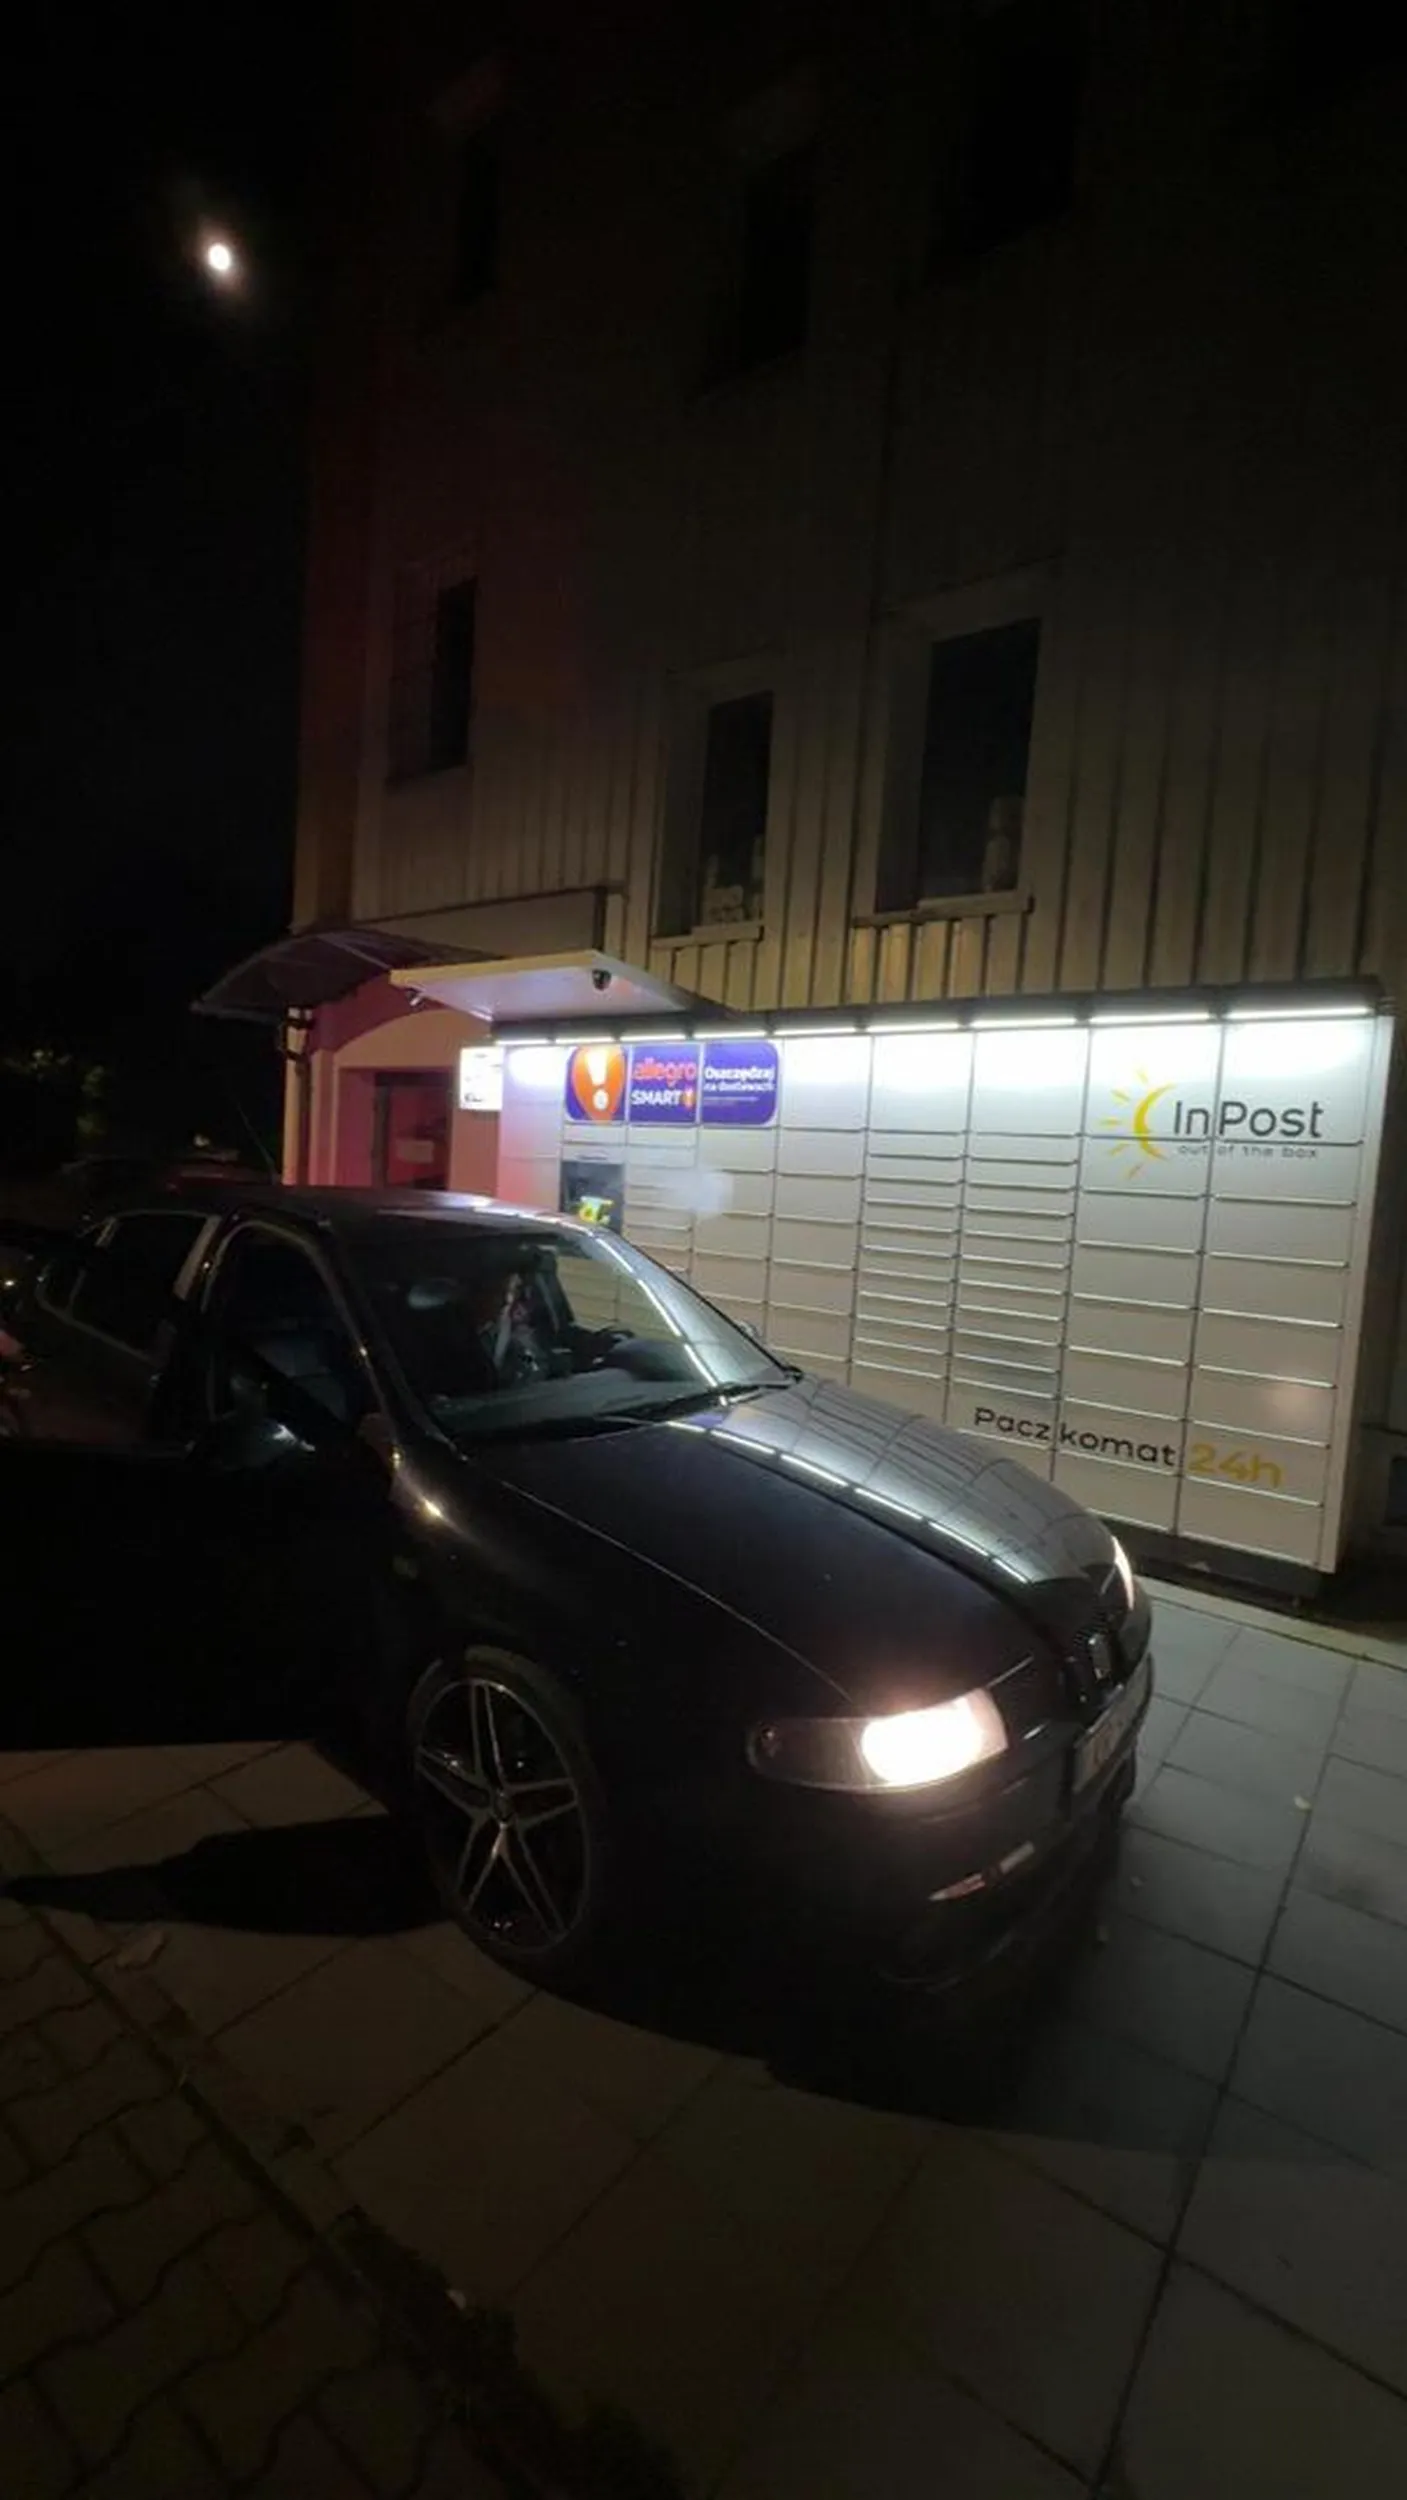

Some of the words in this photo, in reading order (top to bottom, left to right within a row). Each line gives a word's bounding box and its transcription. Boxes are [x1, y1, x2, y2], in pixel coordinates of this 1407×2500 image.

[634, 1057, 697, 1087] allegro
[1173, 1101, 1325, 1139] InPost
[1177, 1145, 1207, 1156] out
[1218, 1144, 1236, 1157] of
[1243, 1145, 1273, 1158] the
[1282, 1145, 1318, 1159] box
[1186, 1442, 1284, 1488] 24h
